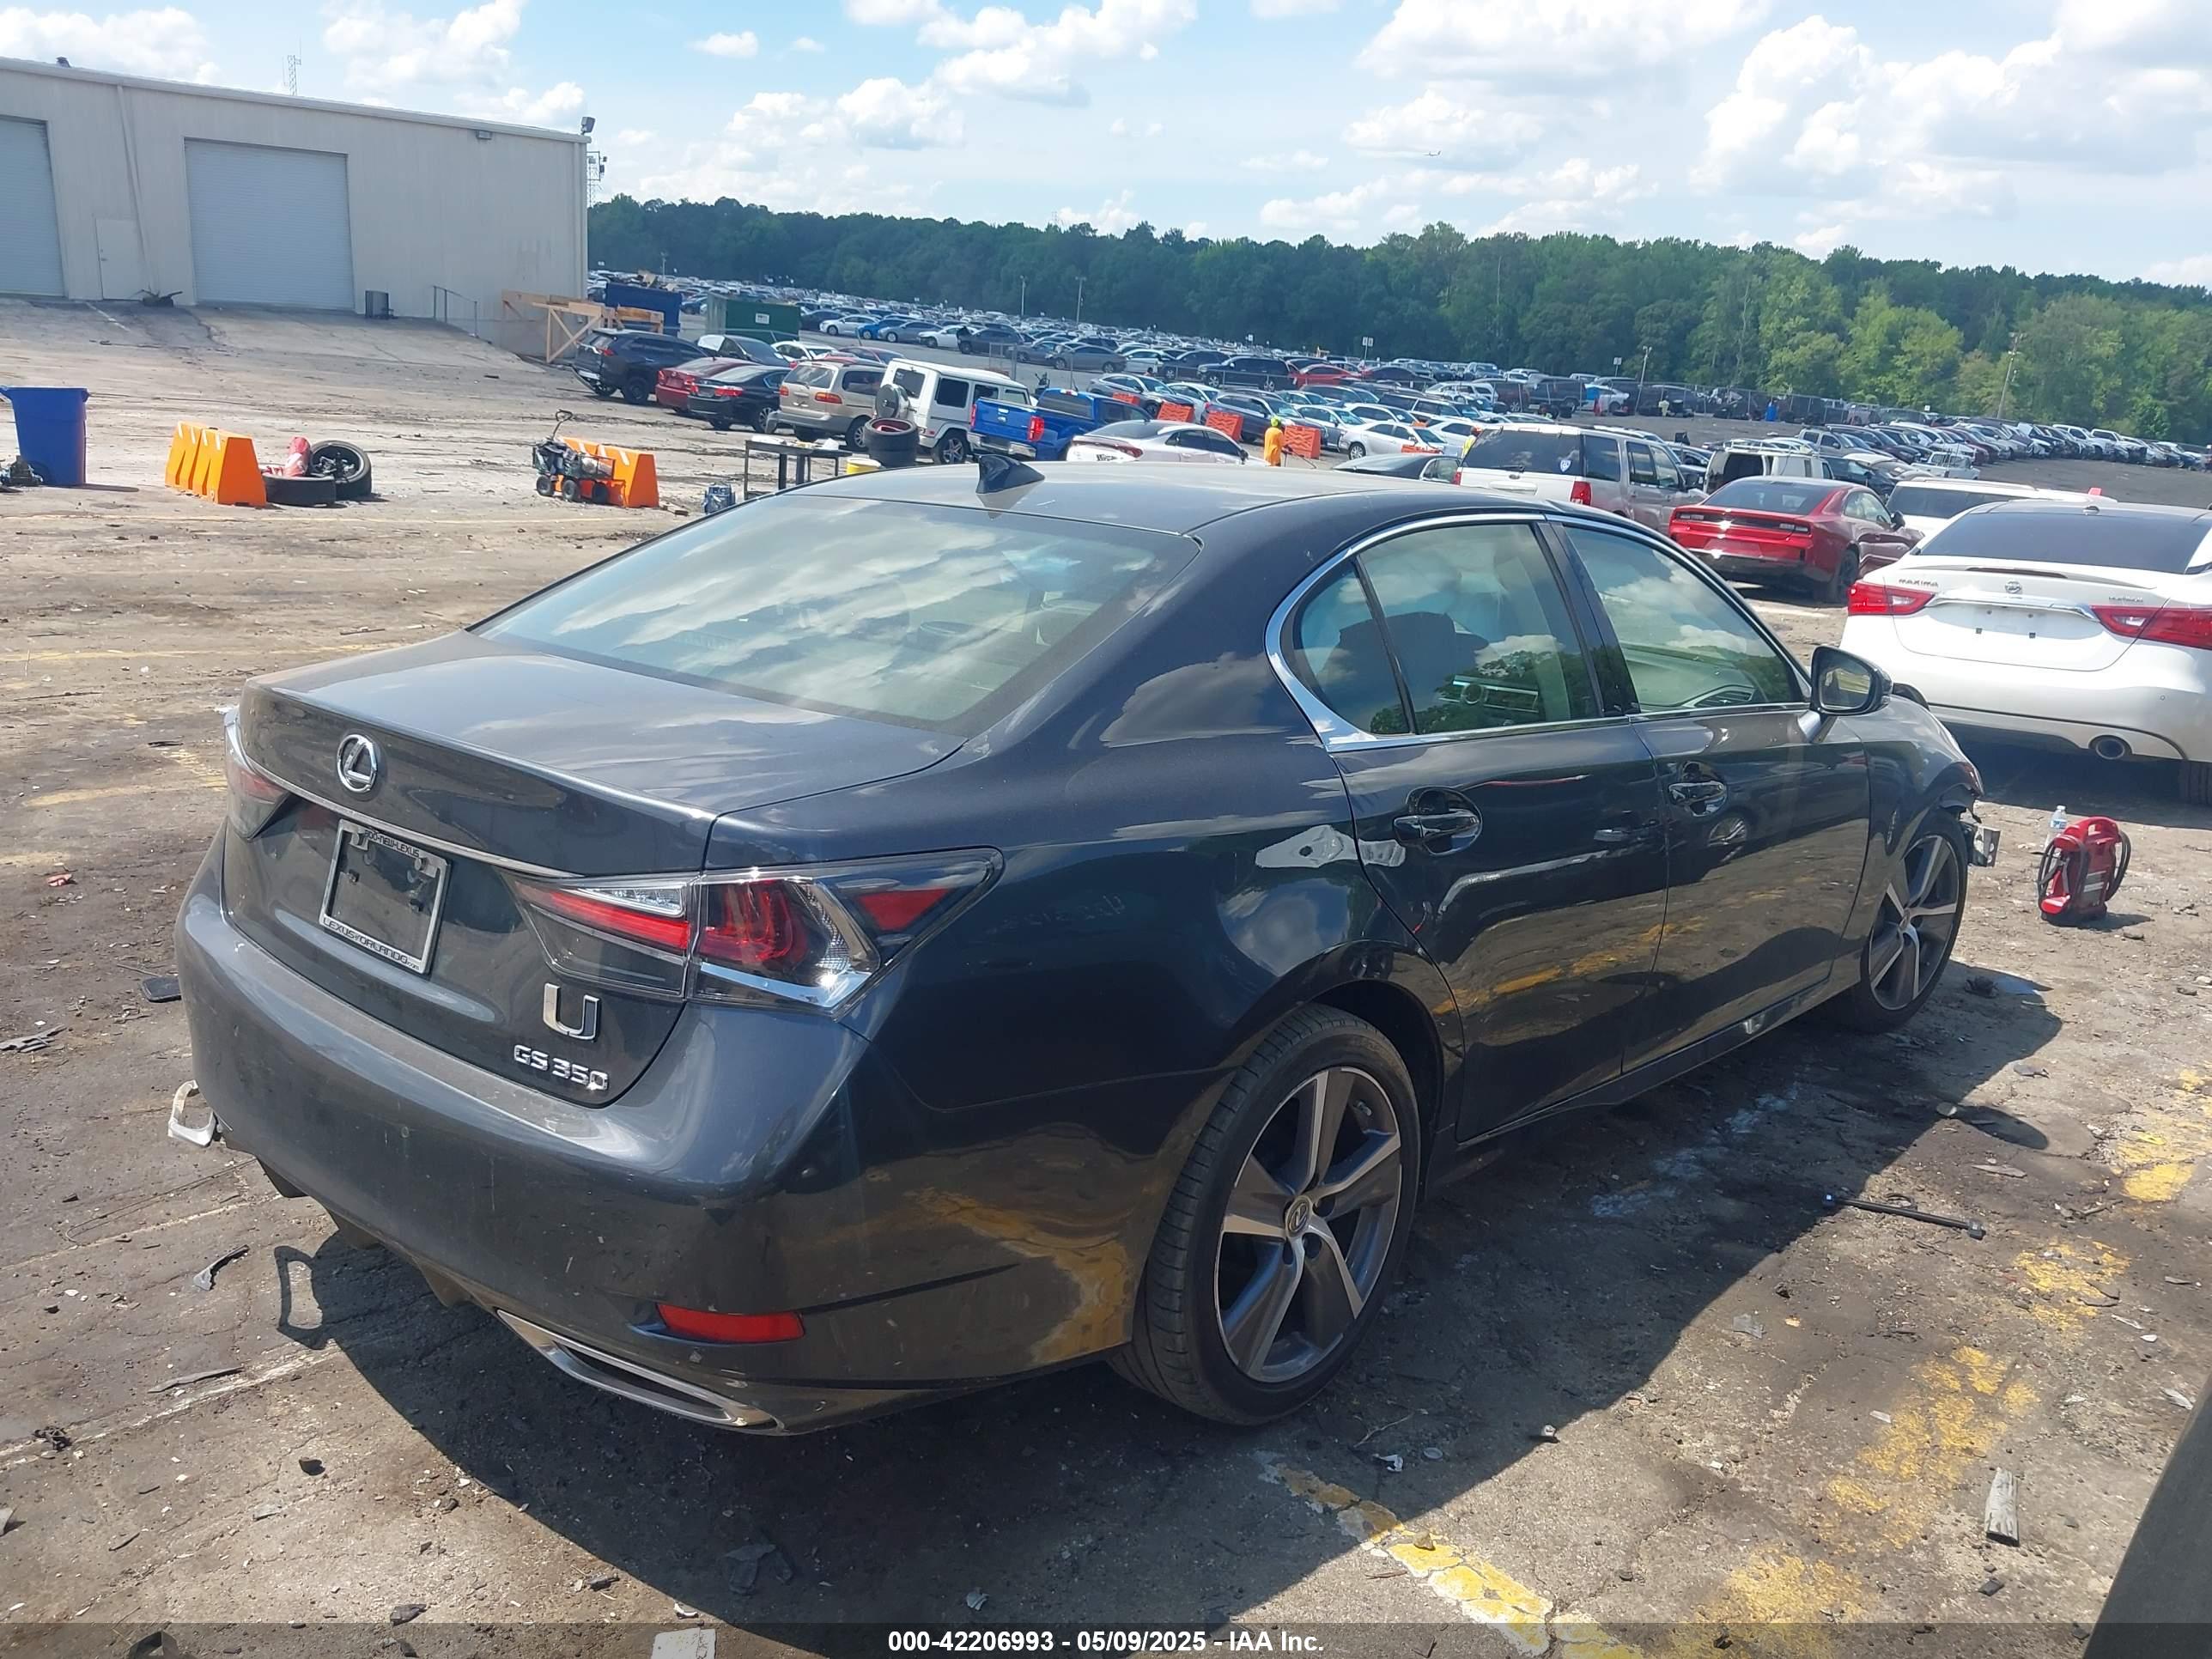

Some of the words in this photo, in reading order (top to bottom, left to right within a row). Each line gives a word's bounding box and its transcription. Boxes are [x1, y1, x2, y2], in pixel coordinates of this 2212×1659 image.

[543, 982, 600, 1040] U
[514, 1044, 549, 1072] GS
[552, 1057, 609, 1091] 350
